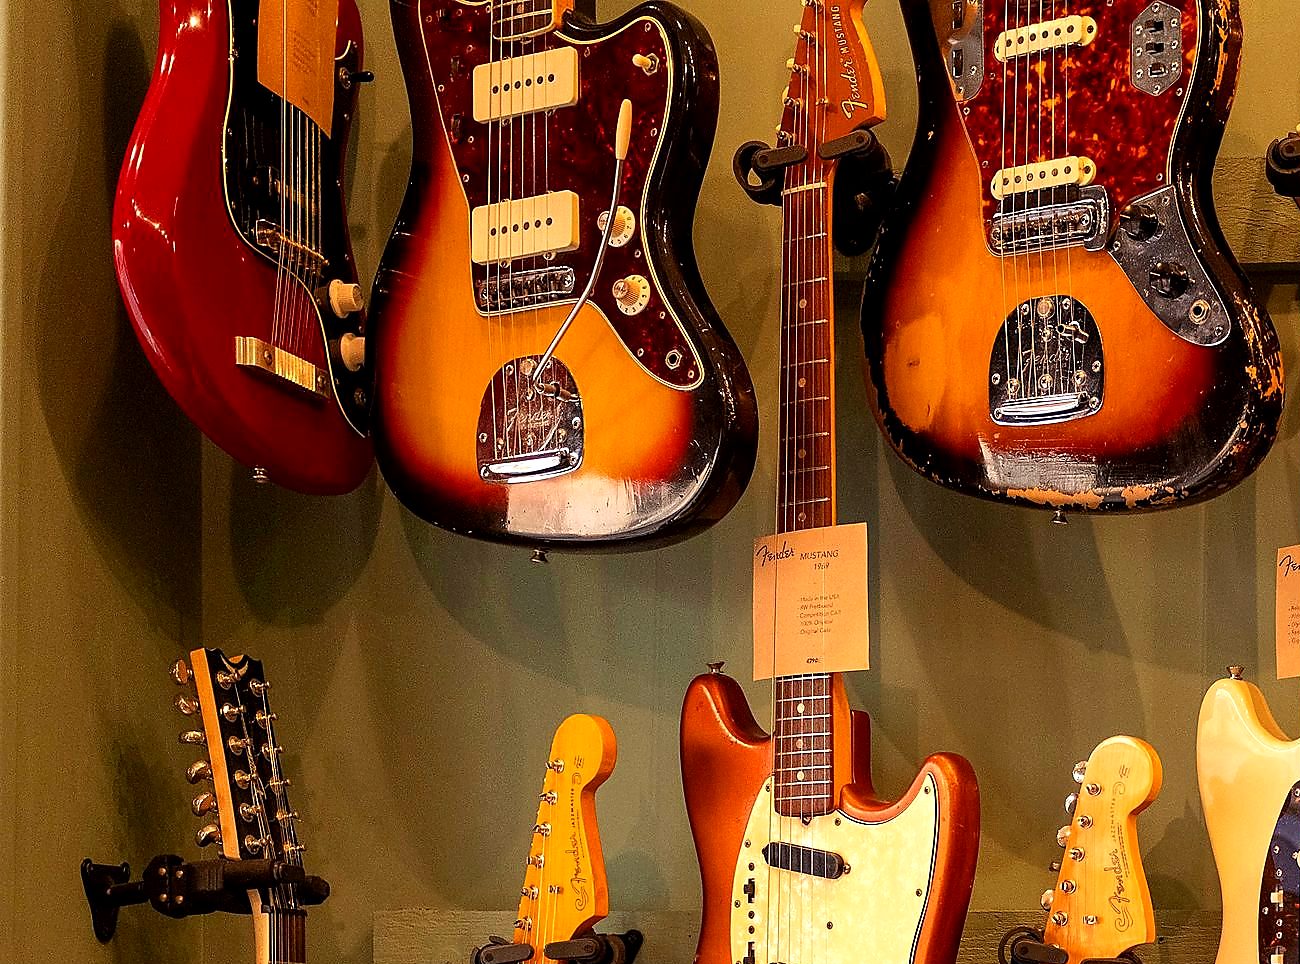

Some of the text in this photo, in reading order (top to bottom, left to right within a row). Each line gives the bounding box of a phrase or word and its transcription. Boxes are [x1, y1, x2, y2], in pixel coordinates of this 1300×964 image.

[831, 6, 868, 118] Fender MUSTANG
[756, 541, 839, 567] Fender MUSTANG
